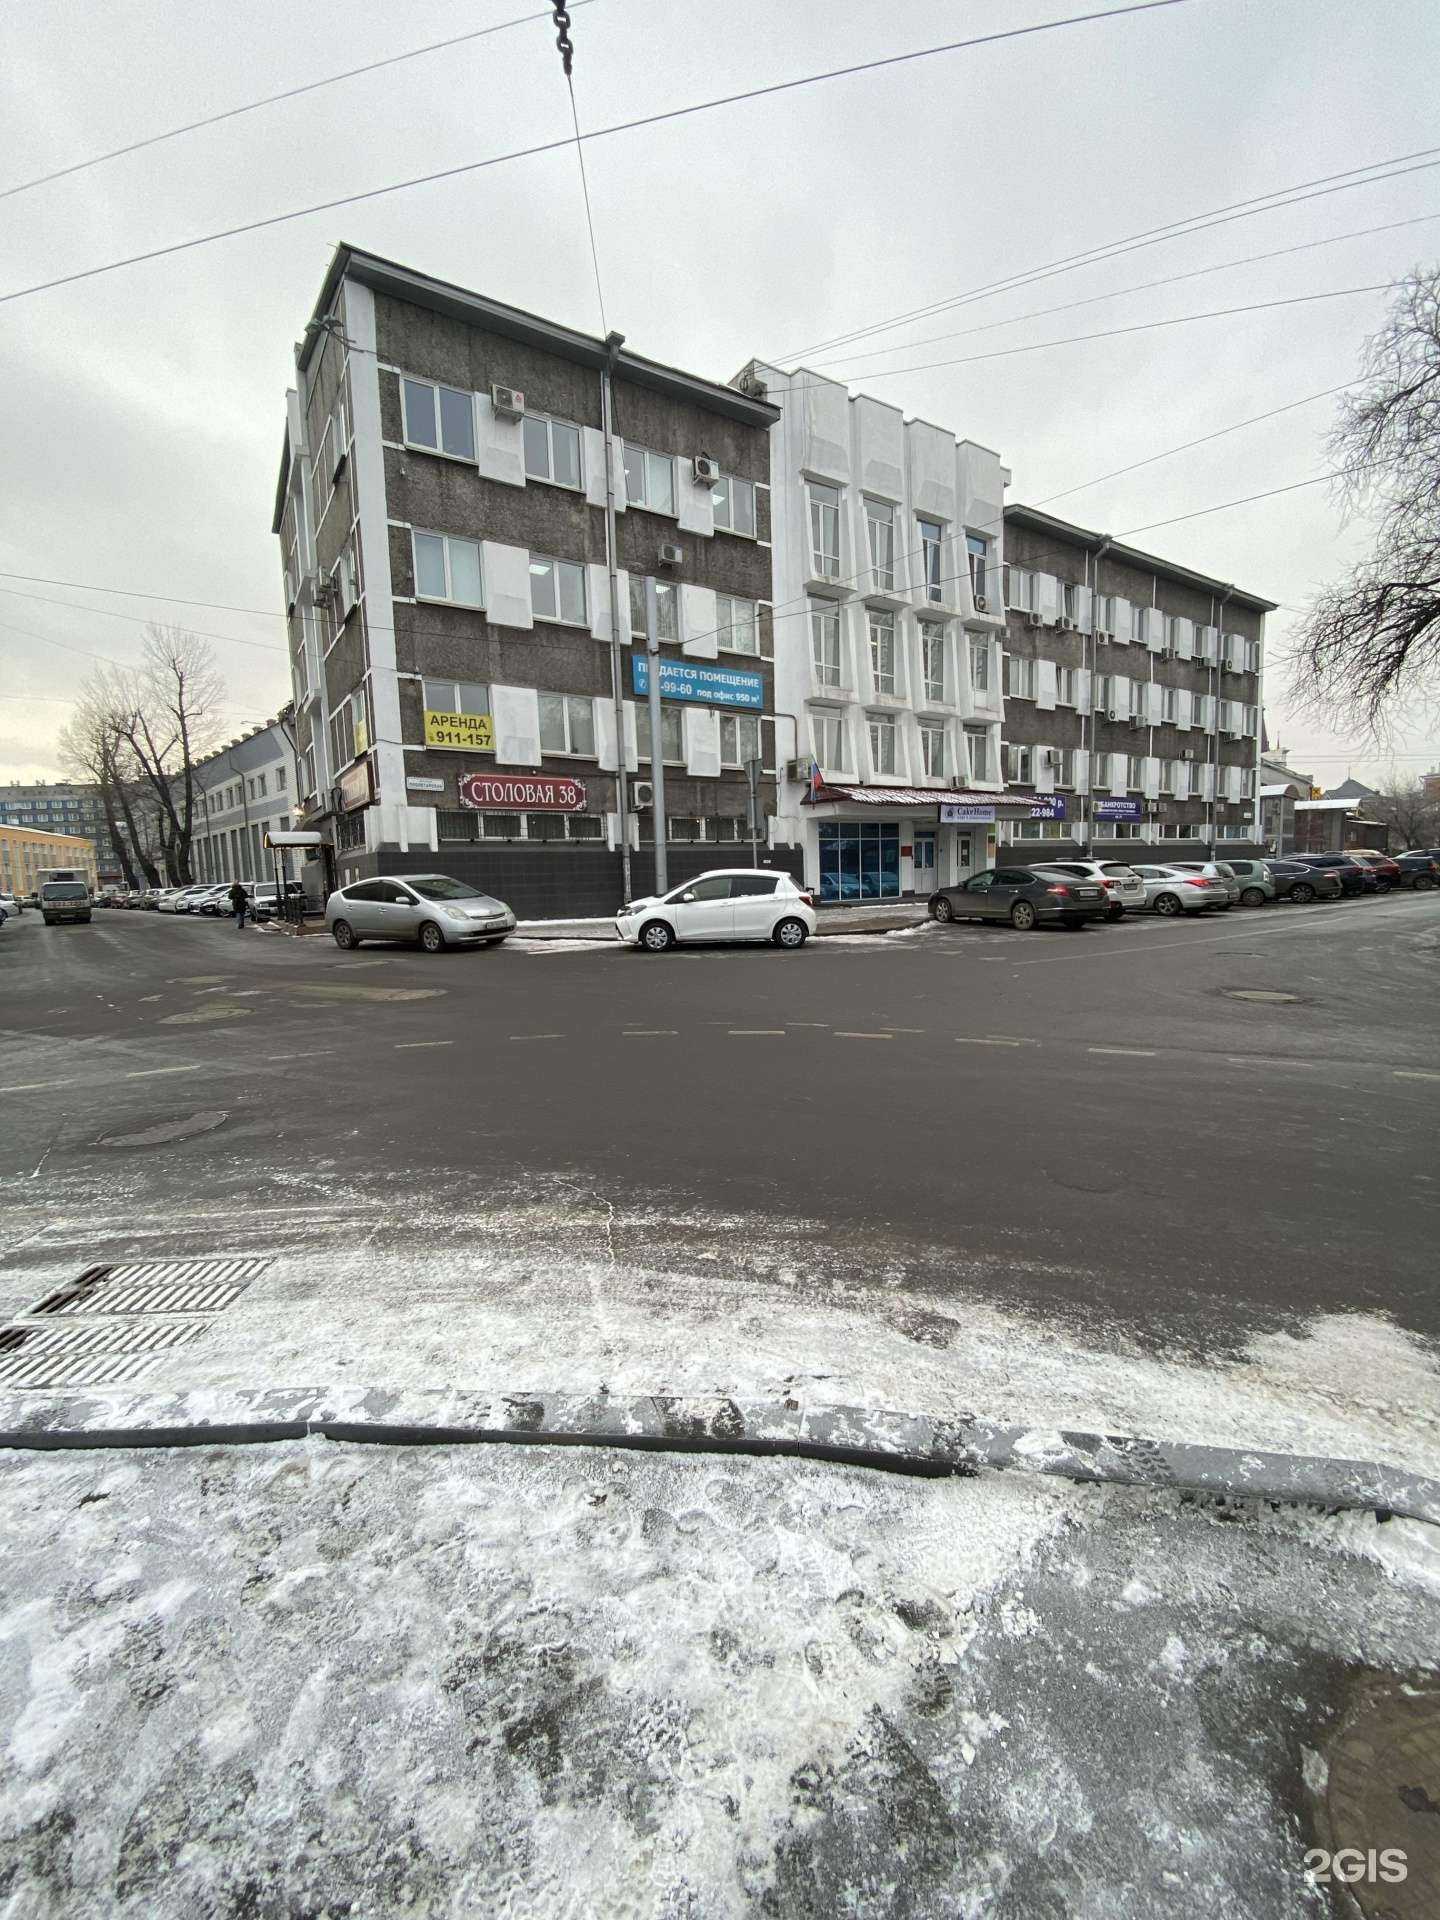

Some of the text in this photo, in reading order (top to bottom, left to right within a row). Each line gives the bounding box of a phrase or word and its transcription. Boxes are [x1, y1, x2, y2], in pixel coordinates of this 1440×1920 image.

[638, 662, 759, 688] ПДАЕТСЯ ПОМЕЩЕНИЕ
[696, 689, 712, 699] под
[713, 692, 734, 701] офис
[735, 693, 750, 702] 950
[430, 714, 488, 731] АРЕНДА
[436, 730, 491, 746] 911-157
[471, 782, 577, 804] СТОЛОВАЯ 38
